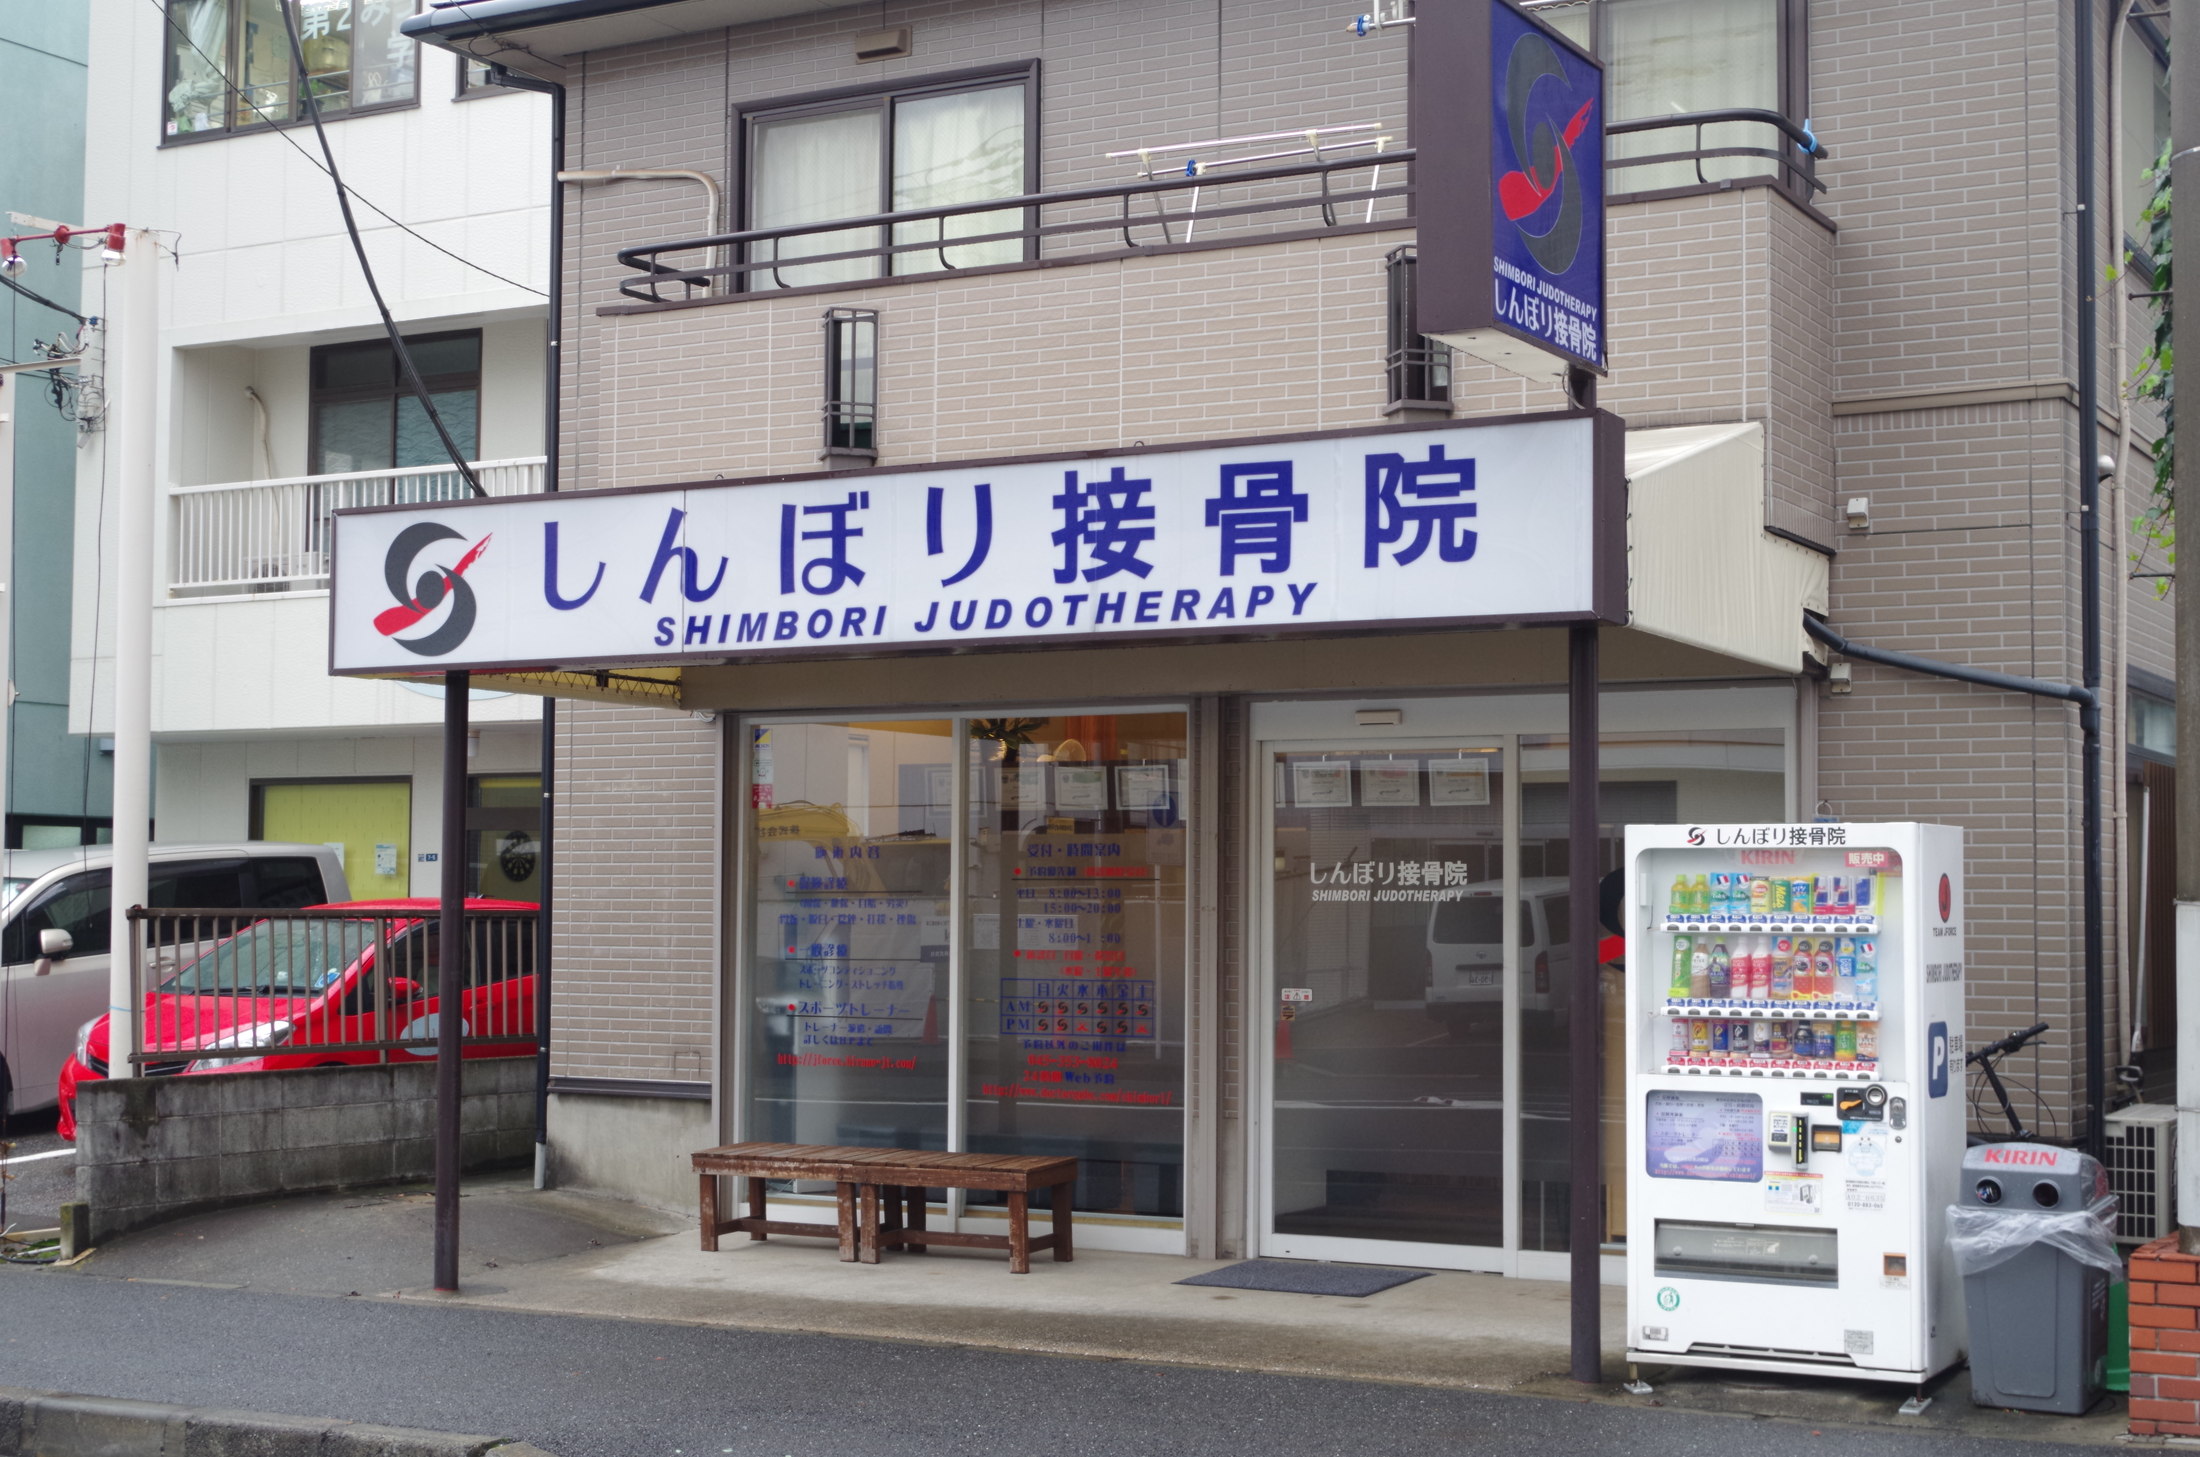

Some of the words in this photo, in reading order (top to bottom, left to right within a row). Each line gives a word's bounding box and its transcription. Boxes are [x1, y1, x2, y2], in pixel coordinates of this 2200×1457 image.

[1494, 256, 1536, 291] SHIMBORI
[1537, 280, 1597, 321] JUDOTHERAPY
[1494, 278, 1597, 361] しんぼり接骨院
[544, 444, 1478, 612] しんぼり接骨院
[654, 605, 887, 646] SHIMBORI
[914, 582, 1318, 632] JUDOTHERAPY
[1716, 826, 1846, 846] しんぼり接骨院
[1740, 850, 1796, 865] KIRIN
[1848, 852, 1885, 865] 販売中
[1310, 860, 1468, 886] しんぼり接骨院
[1312, 889, 1371, 902] SHIMBORI
[1373, 889, 1464, 902] JUDOTHERAPY
[1057, 984, 1070, 997] 火
[1077, 984, 1089, 998] 水
[1096, 984, 1109, 998] 木
[799, 1001, 911, 1017] スポーツトレーナー
[1006, 1000, 1030, 1013] AM
[1006, 1018, 1030, 1031] PM
[1932, 1036, 1945, 1081] P
[1984, 1148, 2059, 1167] KIRIN
